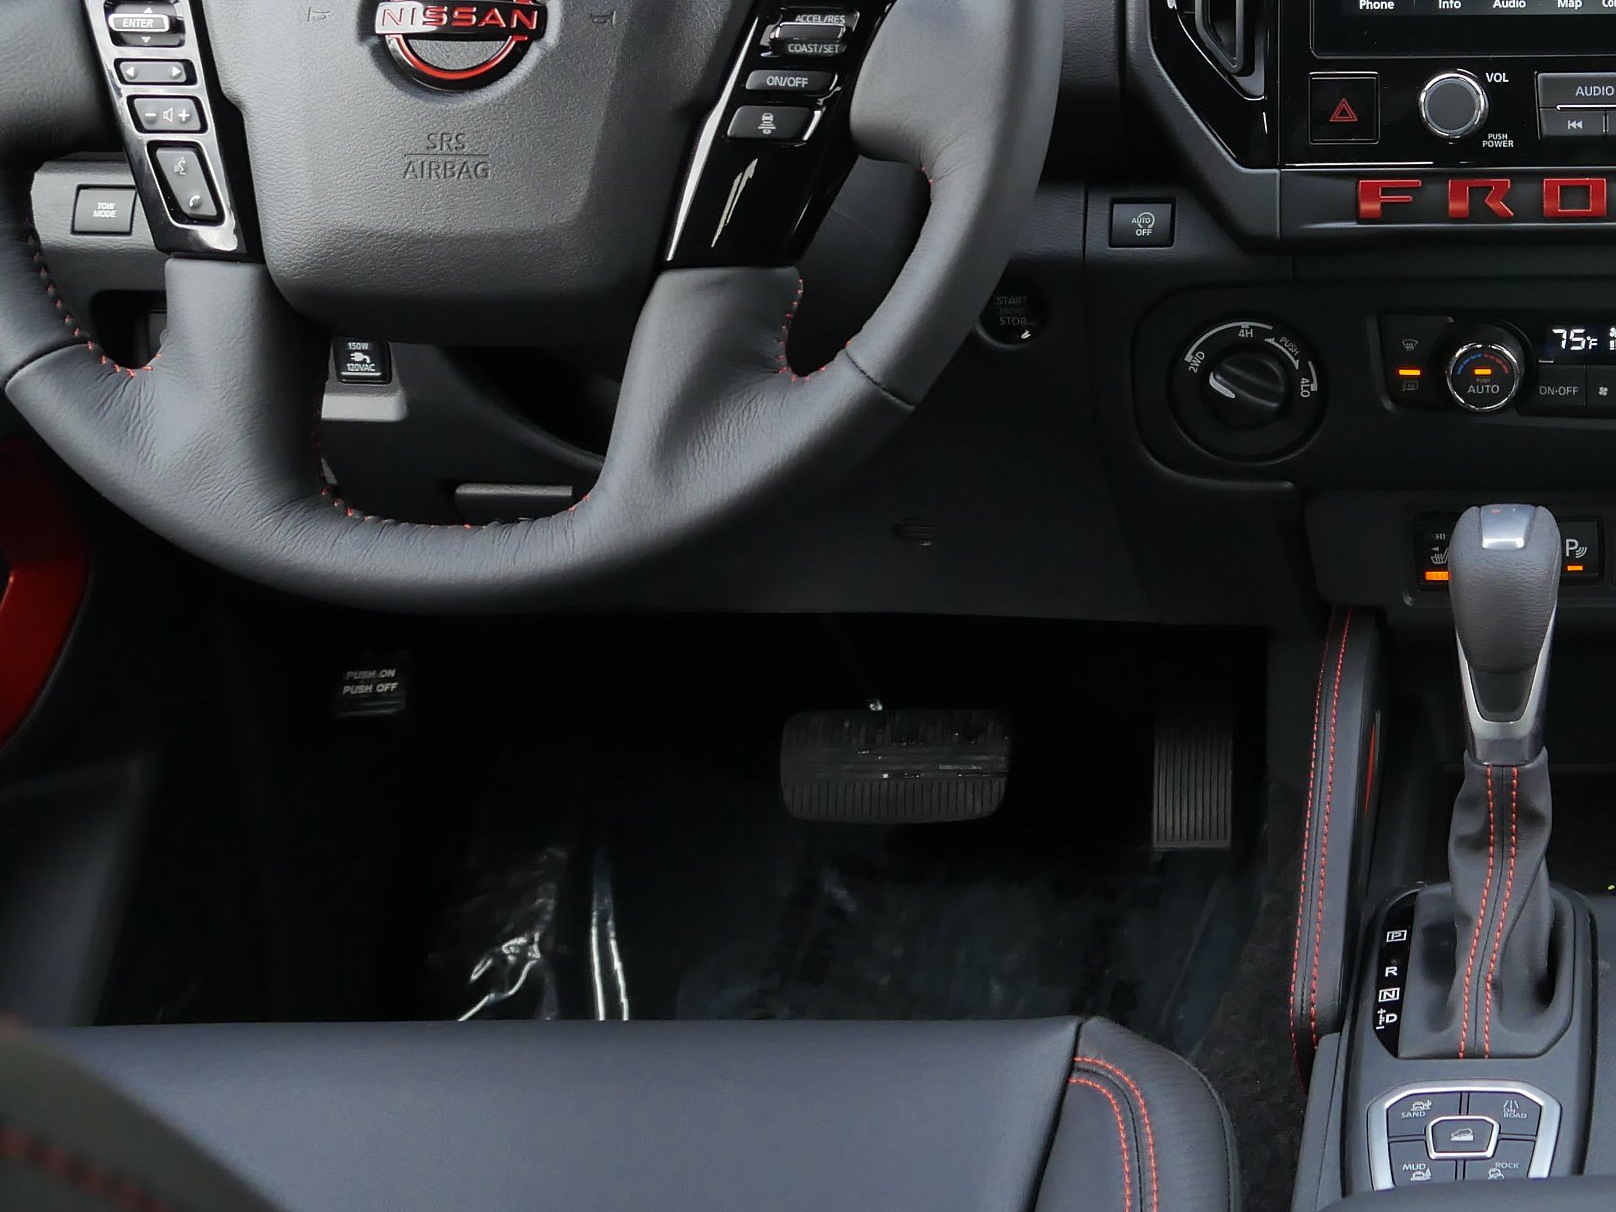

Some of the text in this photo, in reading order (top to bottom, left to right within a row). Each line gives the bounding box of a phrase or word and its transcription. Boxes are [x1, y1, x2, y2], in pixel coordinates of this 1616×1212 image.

[1359, 0, 1394, 10] Phone
[382, 5, 538, 30] NISSAN
[795, 15, 846, 24] ACCEL/RES
[122, 18, 154, 28] ENTER
[788, 44, 840, 53] COAST/SET
[766, 76, 808, 87] ON/OFF
[1486, 73, 1509, 83] VOL
[1575, 86, 1615, 96] AUDIO
[426, 132, 467, 151] SRS
[1482, 140, 1514, 148] POWER
[402, 160, 490, 180] AIRBAG
[97, 202, 115, 210] TOW
[93, 210, 116, 218] MODE
[1136, 228, 1152, 236] OFF
[1000, 316, 1027, 326] STOP
[1238, 329, 1254, 338] 4H
[347, 342, 369, 350] 150W
[1279, 336, 1300, 356] PUSH
[346, 363, 376, 372] 120VAC
[1188, 351, 1206, 374] 2WD
[1300, 377, 1311, 398] 4LO
[1468, 384, 1500, 394] AUTO
[346, 668, 396, 680] PUSH ON
[342, 682, 399, 695] PUSH OFF
[1385, 966, 1398, 978] R
[1383, 990, 1396, 1001] N
[1386, 1013, 1398, 1023] D
[1402, 1163, 1427, 1171] MUD
